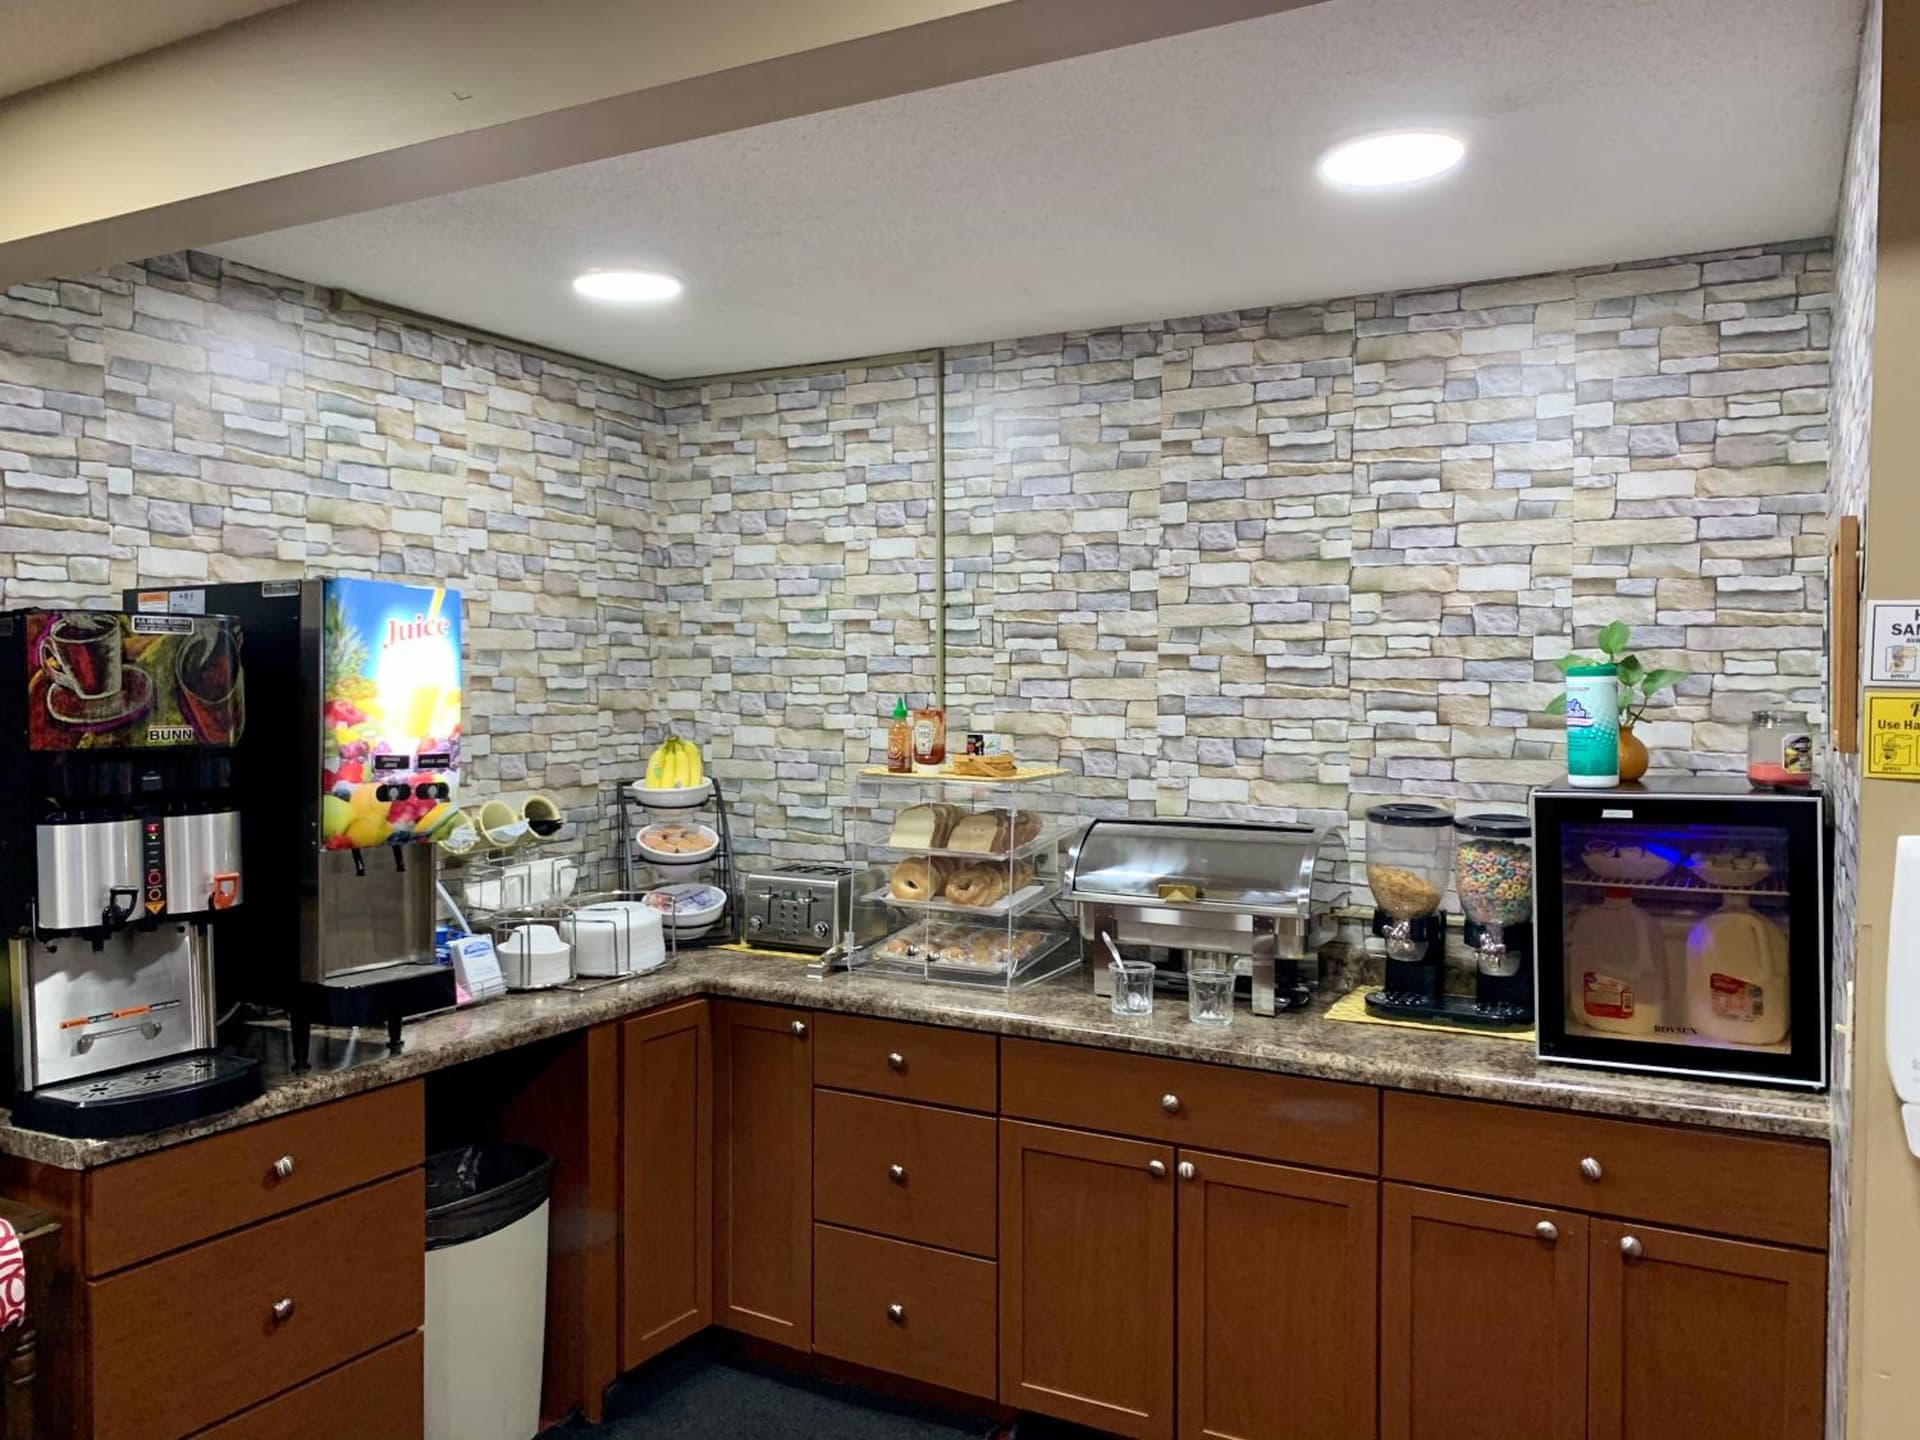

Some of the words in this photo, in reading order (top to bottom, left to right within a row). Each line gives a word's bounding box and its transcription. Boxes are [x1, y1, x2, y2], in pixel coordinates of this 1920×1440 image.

[383, 614, 450, 649] Juice
[1878, 719, 1901, 729] Use
[149, 729, 192, 741] BUNN
